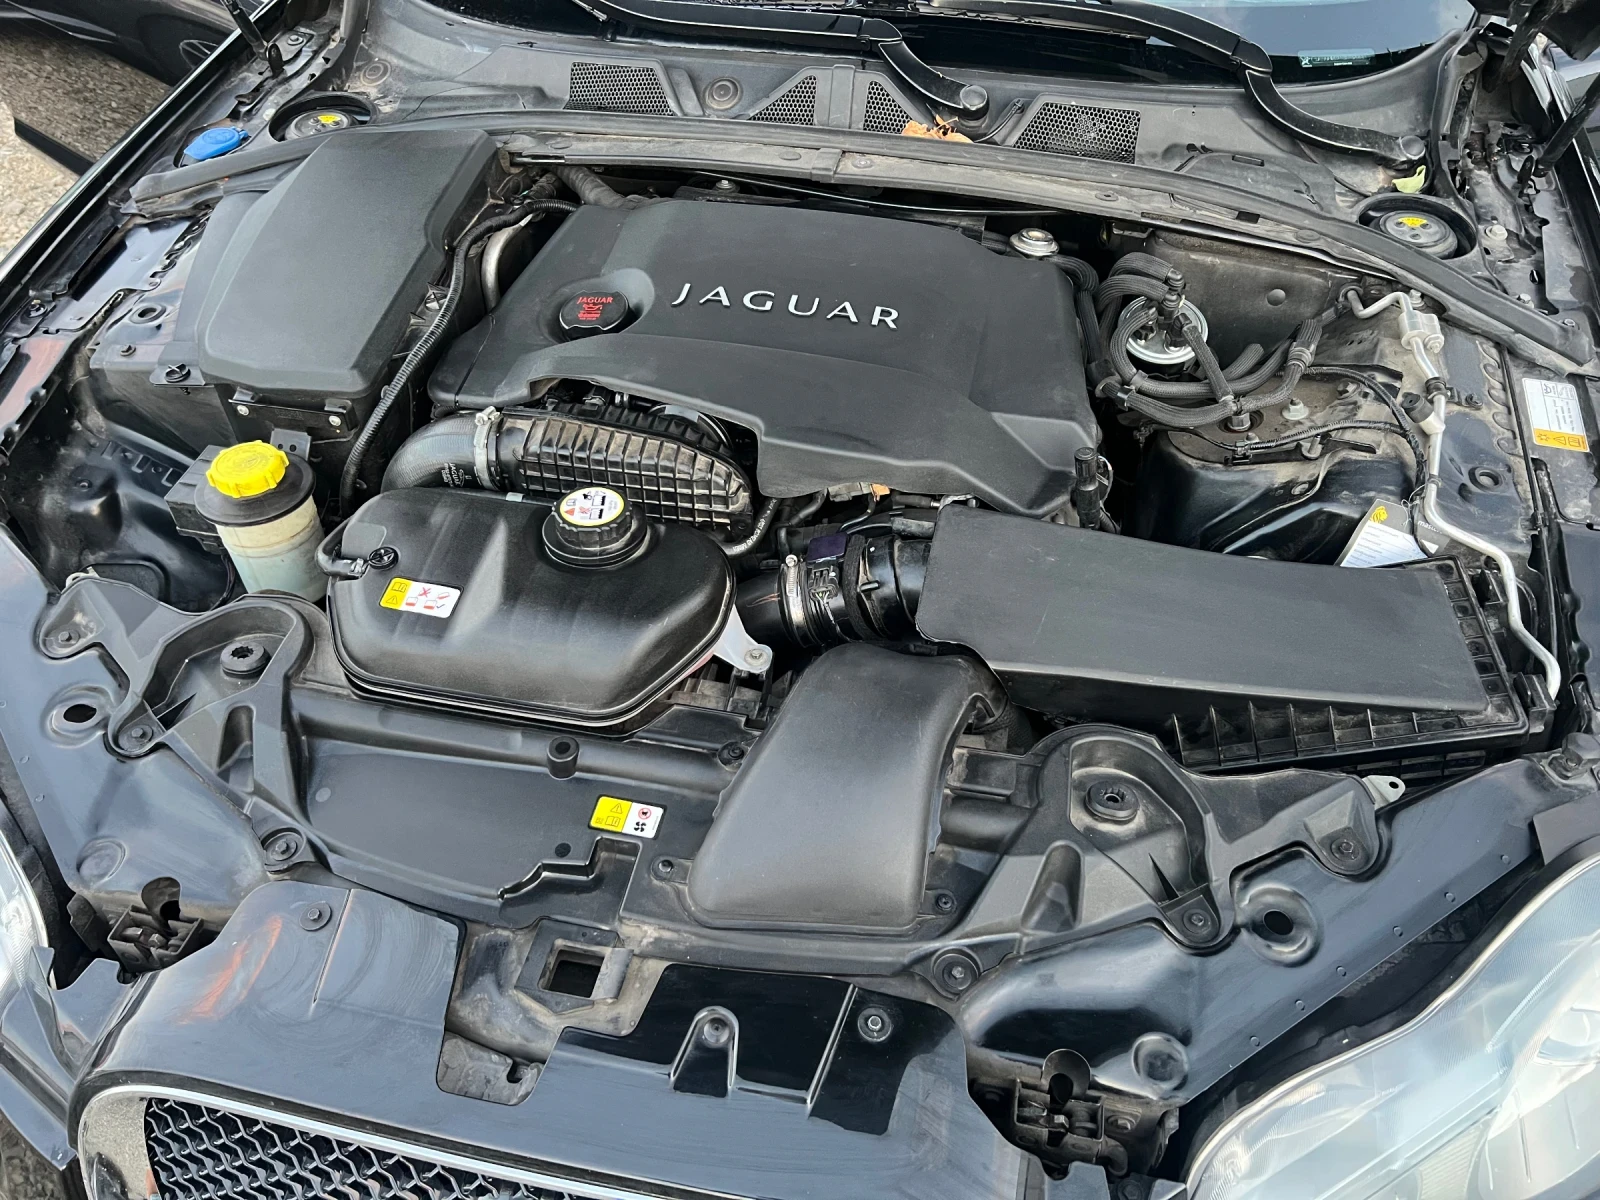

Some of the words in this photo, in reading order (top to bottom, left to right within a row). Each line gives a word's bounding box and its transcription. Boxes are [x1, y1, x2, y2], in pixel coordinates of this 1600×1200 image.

[576, 296, 614, 305] JAGUAR
[671, 283, 900, 330] JAGUAR
[448, 462, 461, 486] JAGUAR
